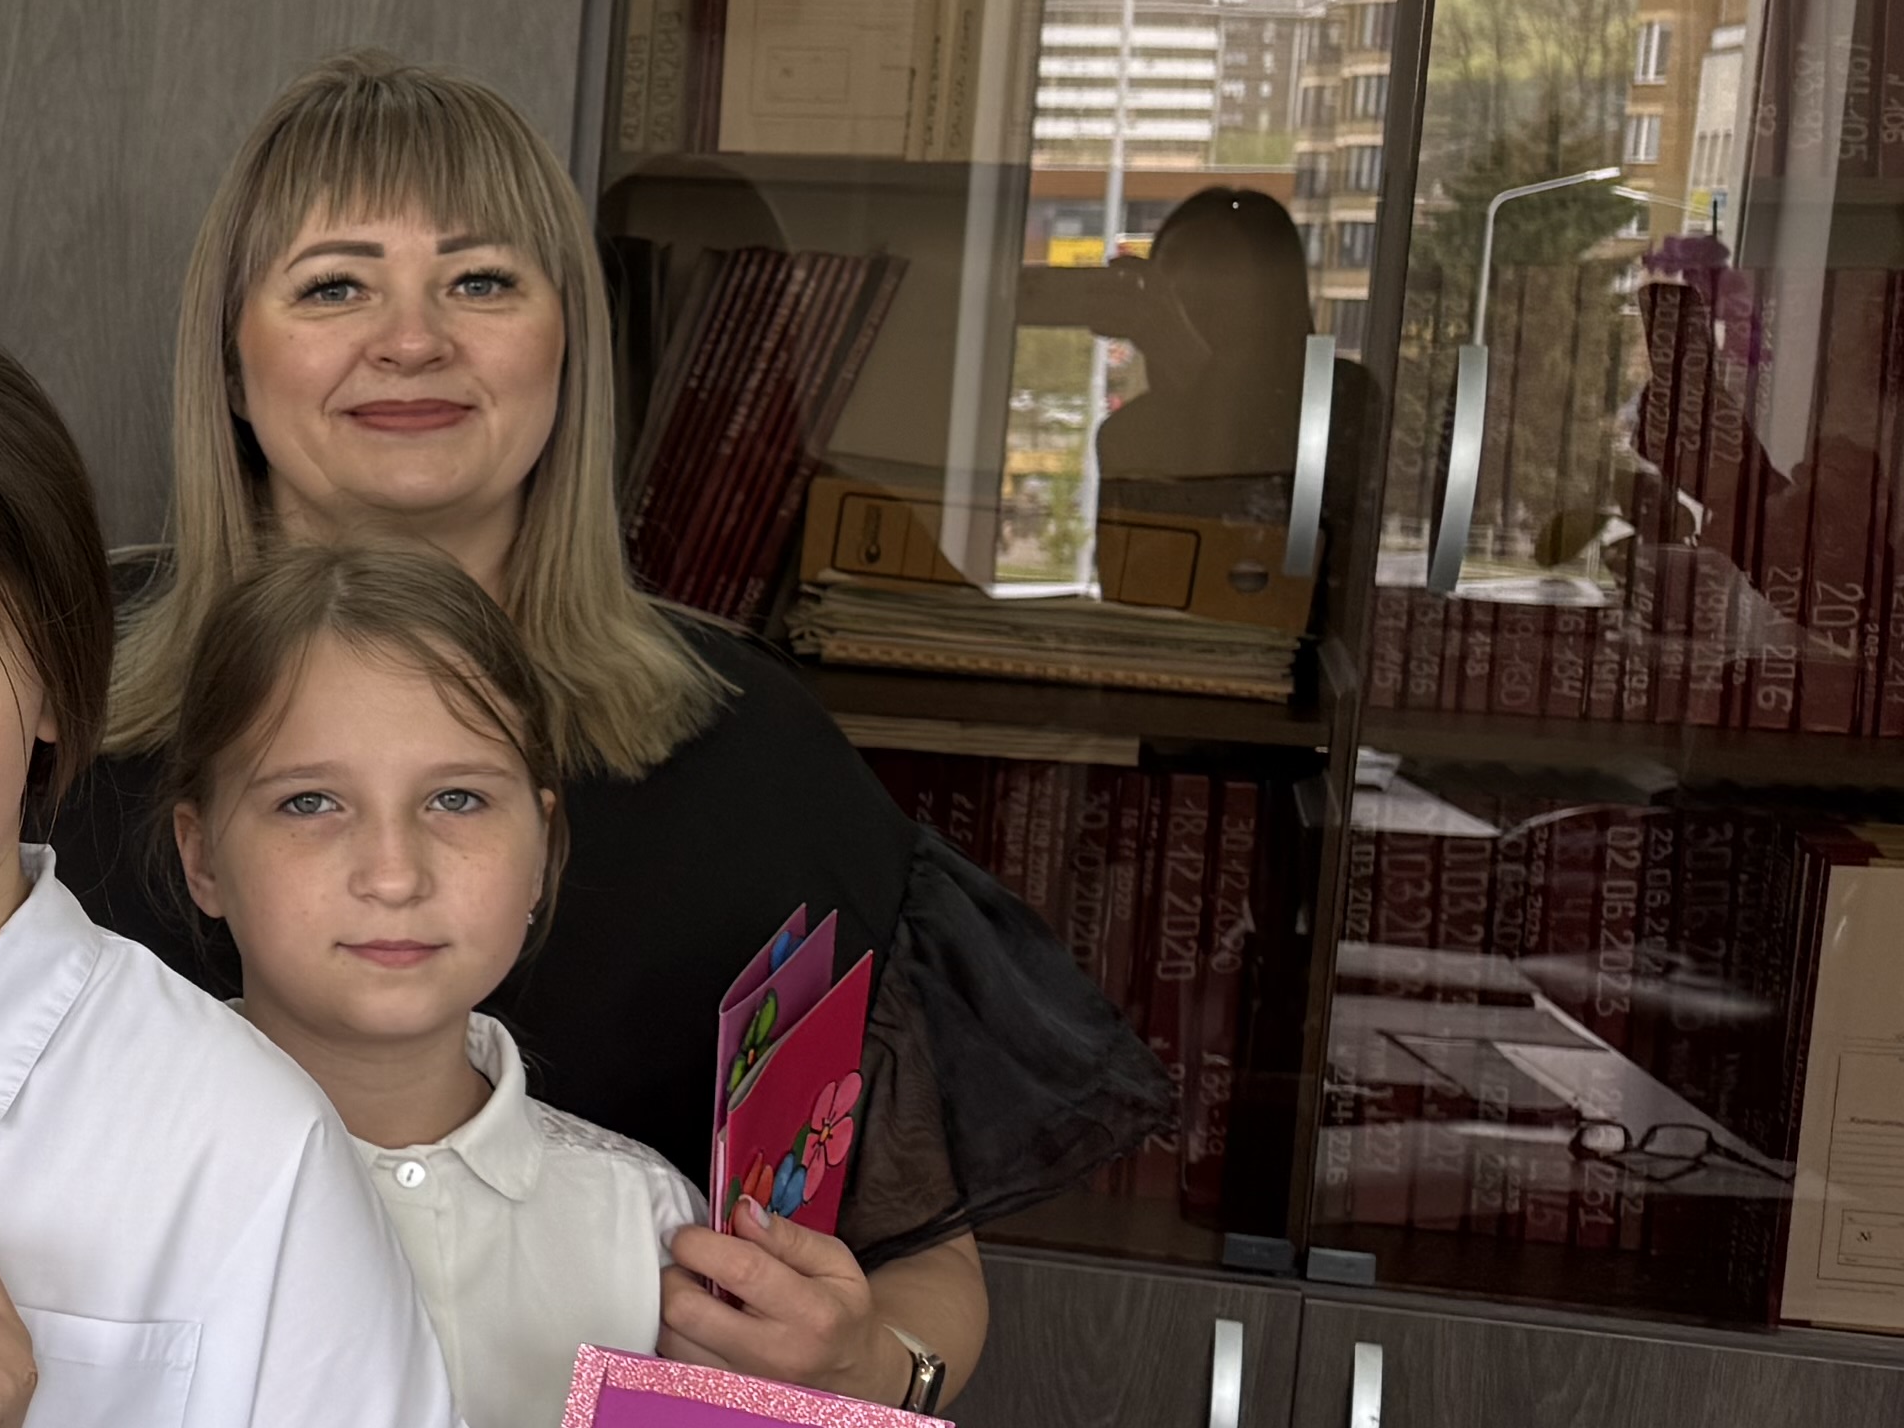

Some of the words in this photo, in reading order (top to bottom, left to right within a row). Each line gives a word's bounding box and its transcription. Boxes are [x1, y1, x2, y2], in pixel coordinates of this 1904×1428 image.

[1808, 580, 1866, 659] 207
[1155, 798, 1210, 982] 18.12.2020
[1595, 825, 1644, 1017] 02.06.2023
